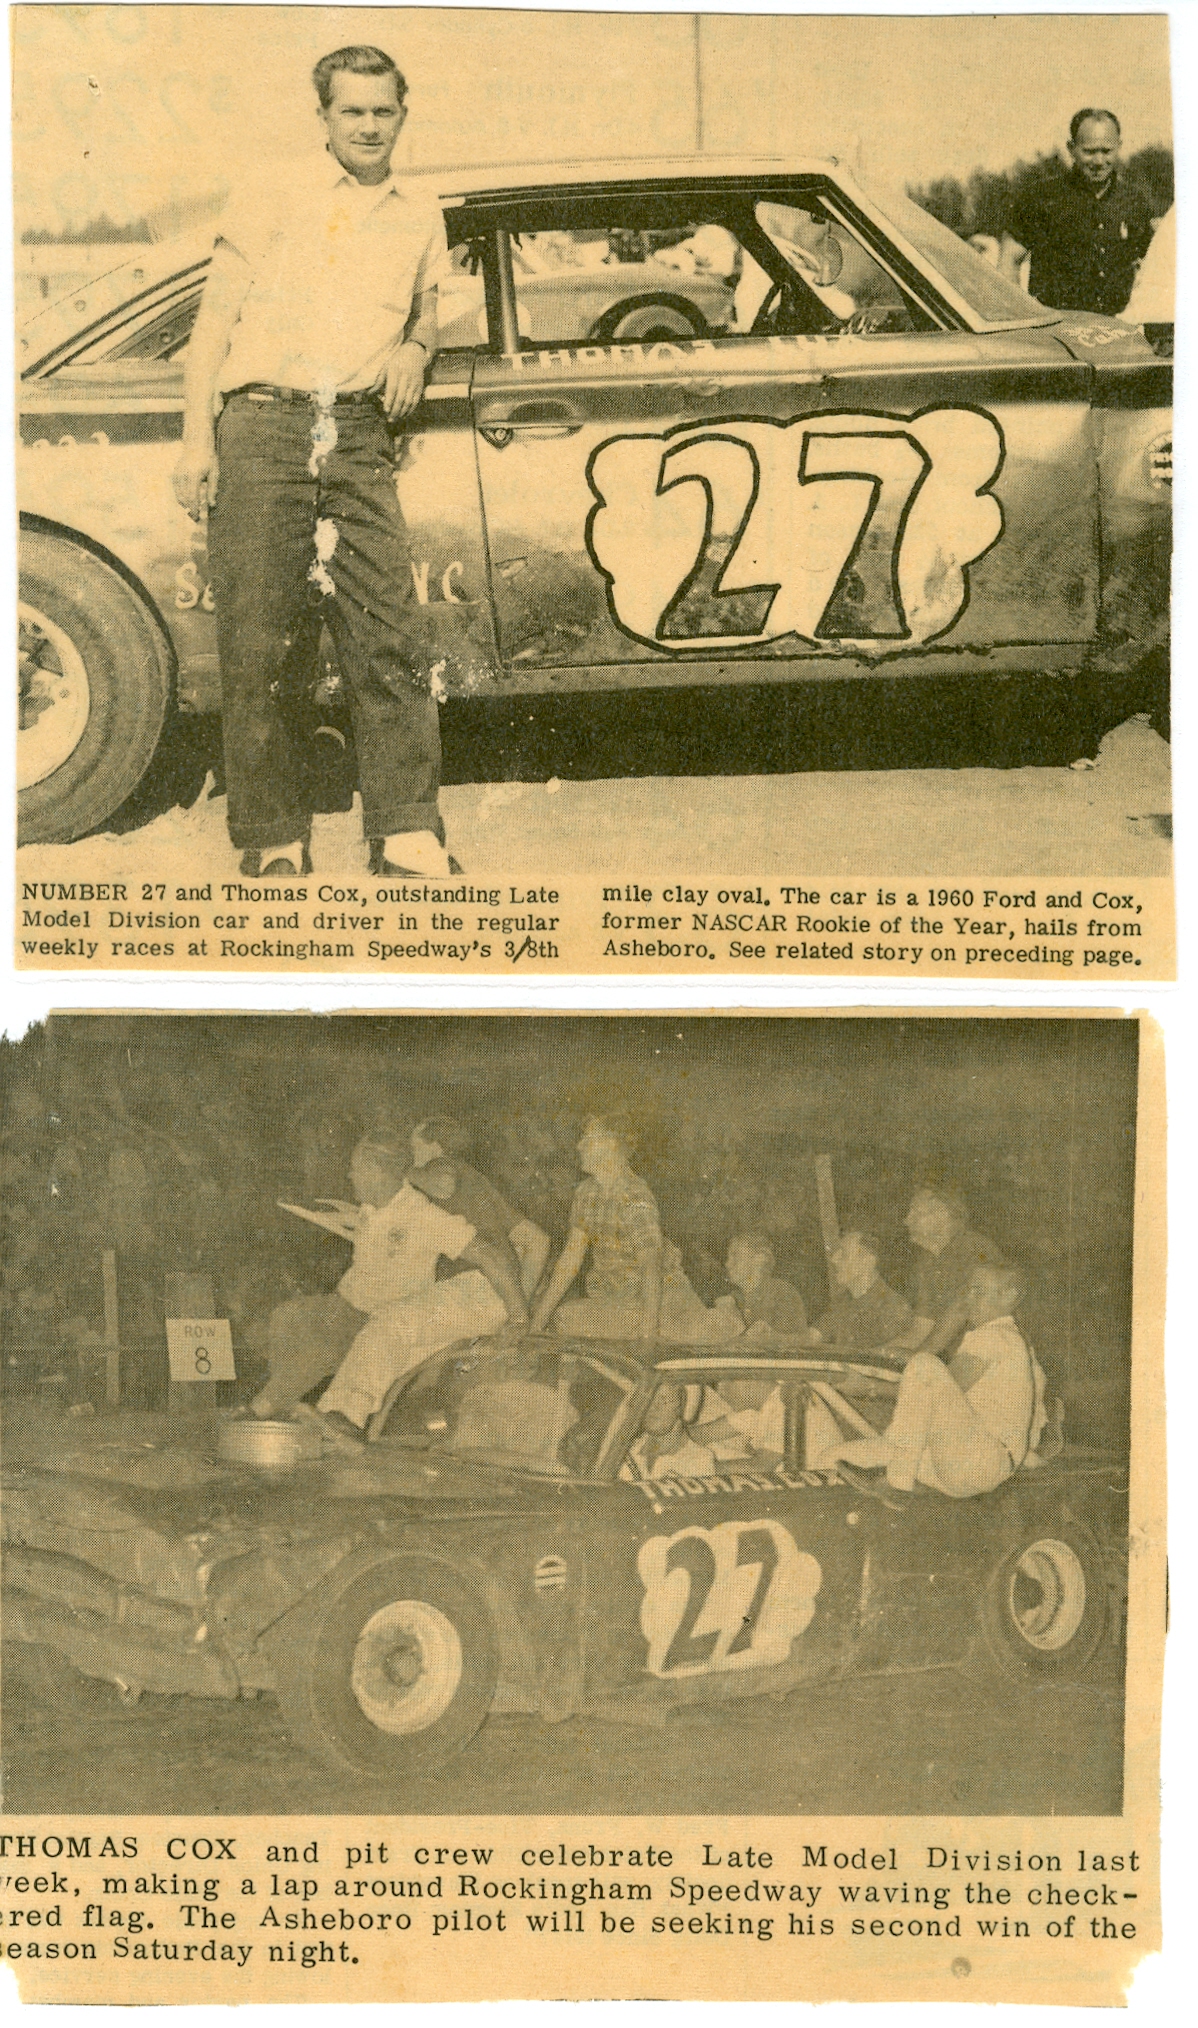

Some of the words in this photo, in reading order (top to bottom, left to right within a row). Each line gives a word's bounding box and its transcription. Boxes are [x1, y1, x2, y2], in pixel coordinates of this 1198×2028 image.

[656, 430, 932, 640] 27
[22, 883, 128, 901] NUMBER
[141, 883, 166, 901] 27
[175, 883, 212, 901] and
[221, 883, 308, 902] Thomas
[317, 885, 367, 908] Cox,
[376, 884, 501, 907] outstanding
[509, 886, 560, 904] Late
[602, 884, 653, 903] mile
[662, 885, 709, 907] clay
[717, 886, 771, 907] oval.
[780, 886, 821, 905] The
[830, 891, 867, 905] car
[876, 888, 897, 906] is
[906, 892, 920, 906] a
[928, 888, 974, 907] 1960
[983, 890, 1037, 909] Ford
[1045, 890, 1083, 909] and
[1092, 891, 1143, 915] Cox,
[22, 909, 91, 928] Model
[108, 911, 200, 929] Division
[213, 915, 250, 929] car
[263, 911, 300, 929] and
[313, 912, 385, 930] driver
[398, 913, 418, 930] in
[431, 912, 464, 931] the
[477, 914, 560, 935] regular
[601, 911, 682, 930] former
[691, 913, 788, 932] NASCAR
[796, 915, 871, 933] Rookie
[879, 916, 903, 934] of
[910, 916, 944, 935] the
[953, 917, 1015, 941] Year,
[1024, 917, 1078, 936] hails
[1086, 919, 1142, 937] from
[21, 938, 99, 959] weekly
[111, 942, 175, 957] races
[187, 938, 208, 956] at
[220, 939, 355, 961] Rockingham
[367, 939, 492, 962] Speedway's
[504, 934, 559, 964] 3/8th
[602, 938, 716, 960] Asheboro.
[729, 940, 766, 959] See
[775, 941, 854, 960] related
[862, 942, 924, 965] story
[930, 947, 957, 962] on
[965, 945, 1075, 967] preceding
[1083, 949, 1142, 967] page.
[184, 1325, 216, 1338] ROW
[195, 1347, 211, 1375] 8
[661, 1529, 779, 1672] 27
[0, 1835, 138, 1859] THOMAS
[166, 1837, 237, 1860] COX
[266, 1841, 319, 1864] and
[345, 1842, 389, 1869] pit
[414, 1847, 494, 1866] crew
[521, 1843, 673, 1868] celebrate
[701, 1844, 773, 1869] Late
[802, 1845, 898, 1871] Model
[926, 1847, 1062, 1872] Division
[1077, 1850, 1140, 1872] last
[102, 1873, 220, 1902] making
[240, 1878, 257, 1895] a
[270, 1873, 318, 1902] lap
[334, 1875, 443, 1898] around
[457, 1874, 652, 1906] Rockingham
[670, 1876, 822, 1908] Speedway
[838, 1882, 951, 1910] waving
[964, 1881, 1011, 1905] the
[1027, 1882, 1138, 1906] check-
[0, 1904, 62, 1927] red
[82, 1903, 154, 1934] flag.
[179, 1905, 236, 1930] The
[259, 1905, 412, 1931] Asheboro
[432, 1908, 507, 1936] pilot
[525, 1909, 585, 1933] will
[599, 1910, 635, 1934] be
[651, 1912, 775, 1942] seeking
[788, 1912, 834, 1936] his
[851, 1915, 962, 1937] second
[976, 1916, 1031, 1938] win
[1046, 1914, 1076, 1938] of
[1089, 1916, 1137, 1940] the
[0, 1942, 97, 1960] eason
[113, 1936, 254, 1968] Saturday
[268, 1940, 359, 1969] night.
